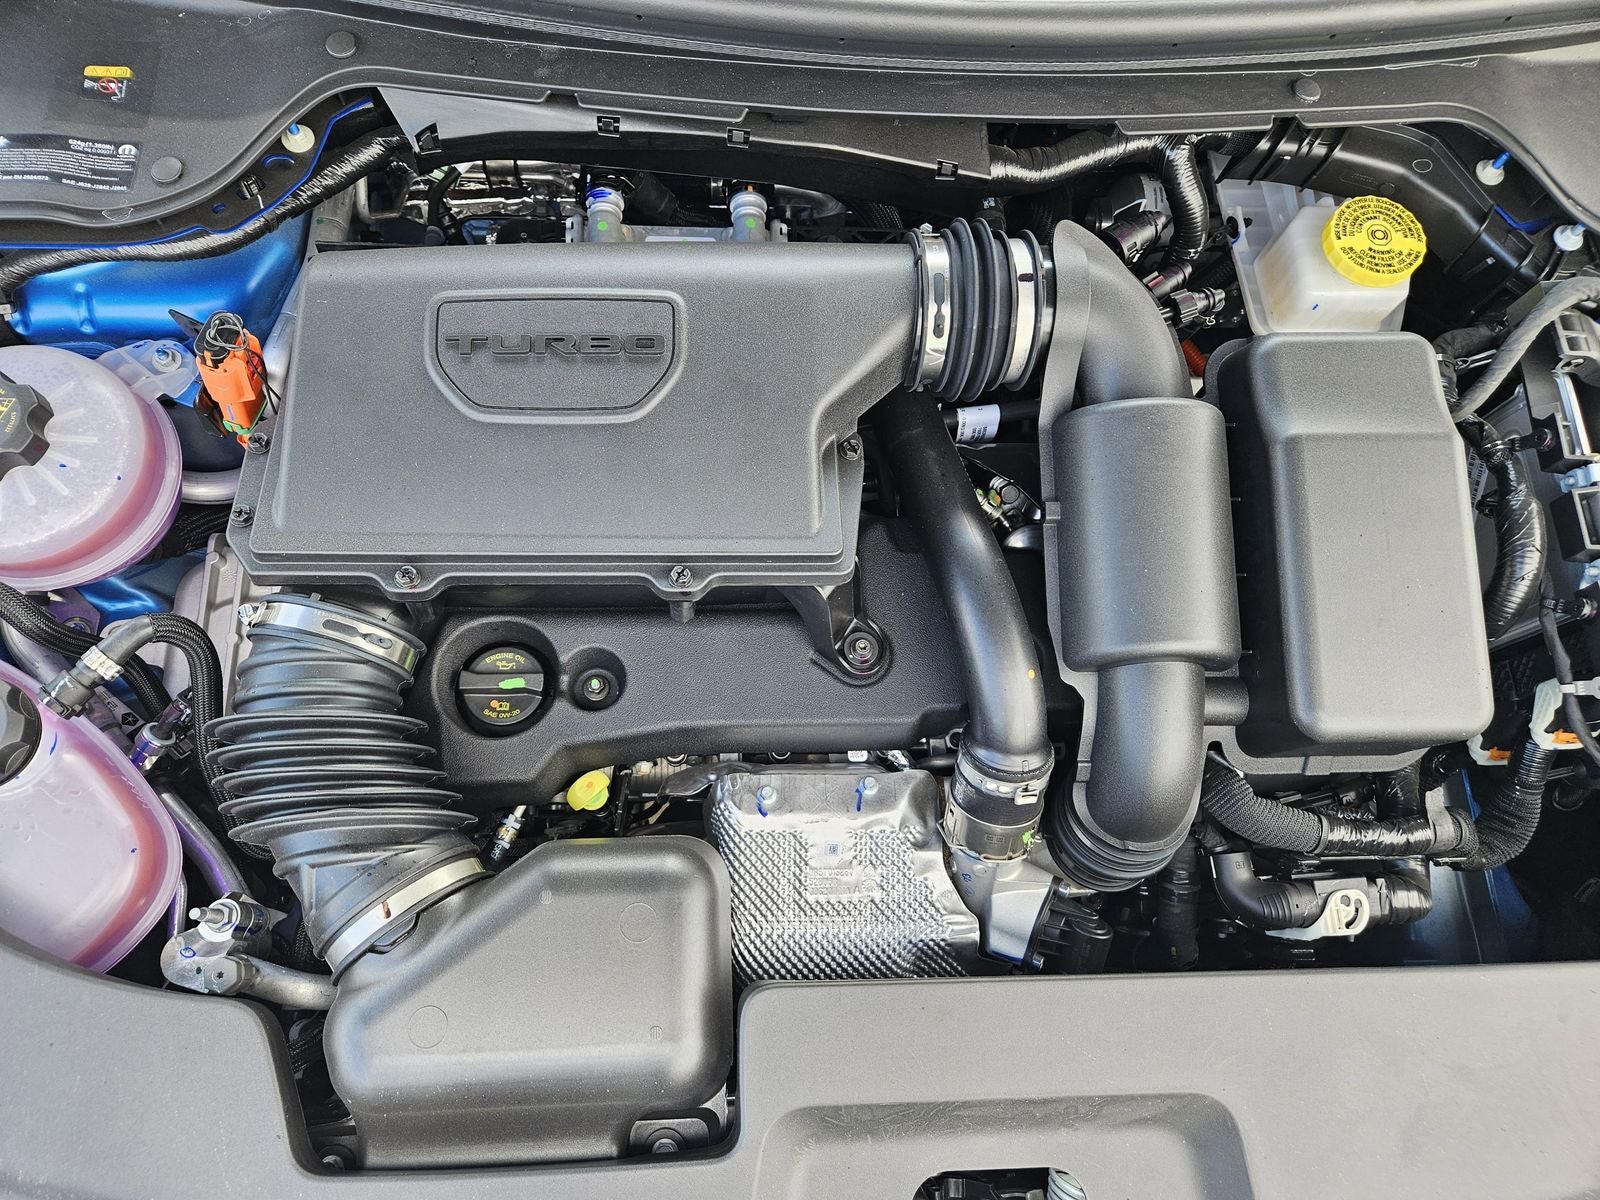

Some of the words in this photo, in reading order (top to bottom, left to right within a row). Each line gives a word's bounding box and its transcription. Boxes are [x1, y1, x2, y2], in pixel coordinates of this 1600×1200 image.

[1347, 246, 1365, 261] BEFORE
[1359, 249, 1376, 261] CLEAN
[1377, 254, 1395, 263] FILLER
[1366, 265, 1380, 273] FROM
[444, 333, 666, 358] TURBO
[485, 652, 514, 664] ENGINE
[514, 654, 526, 664] OIL
[483, 708, 498, 718] SAE
[498, 709, 520, 718] 0W-20
